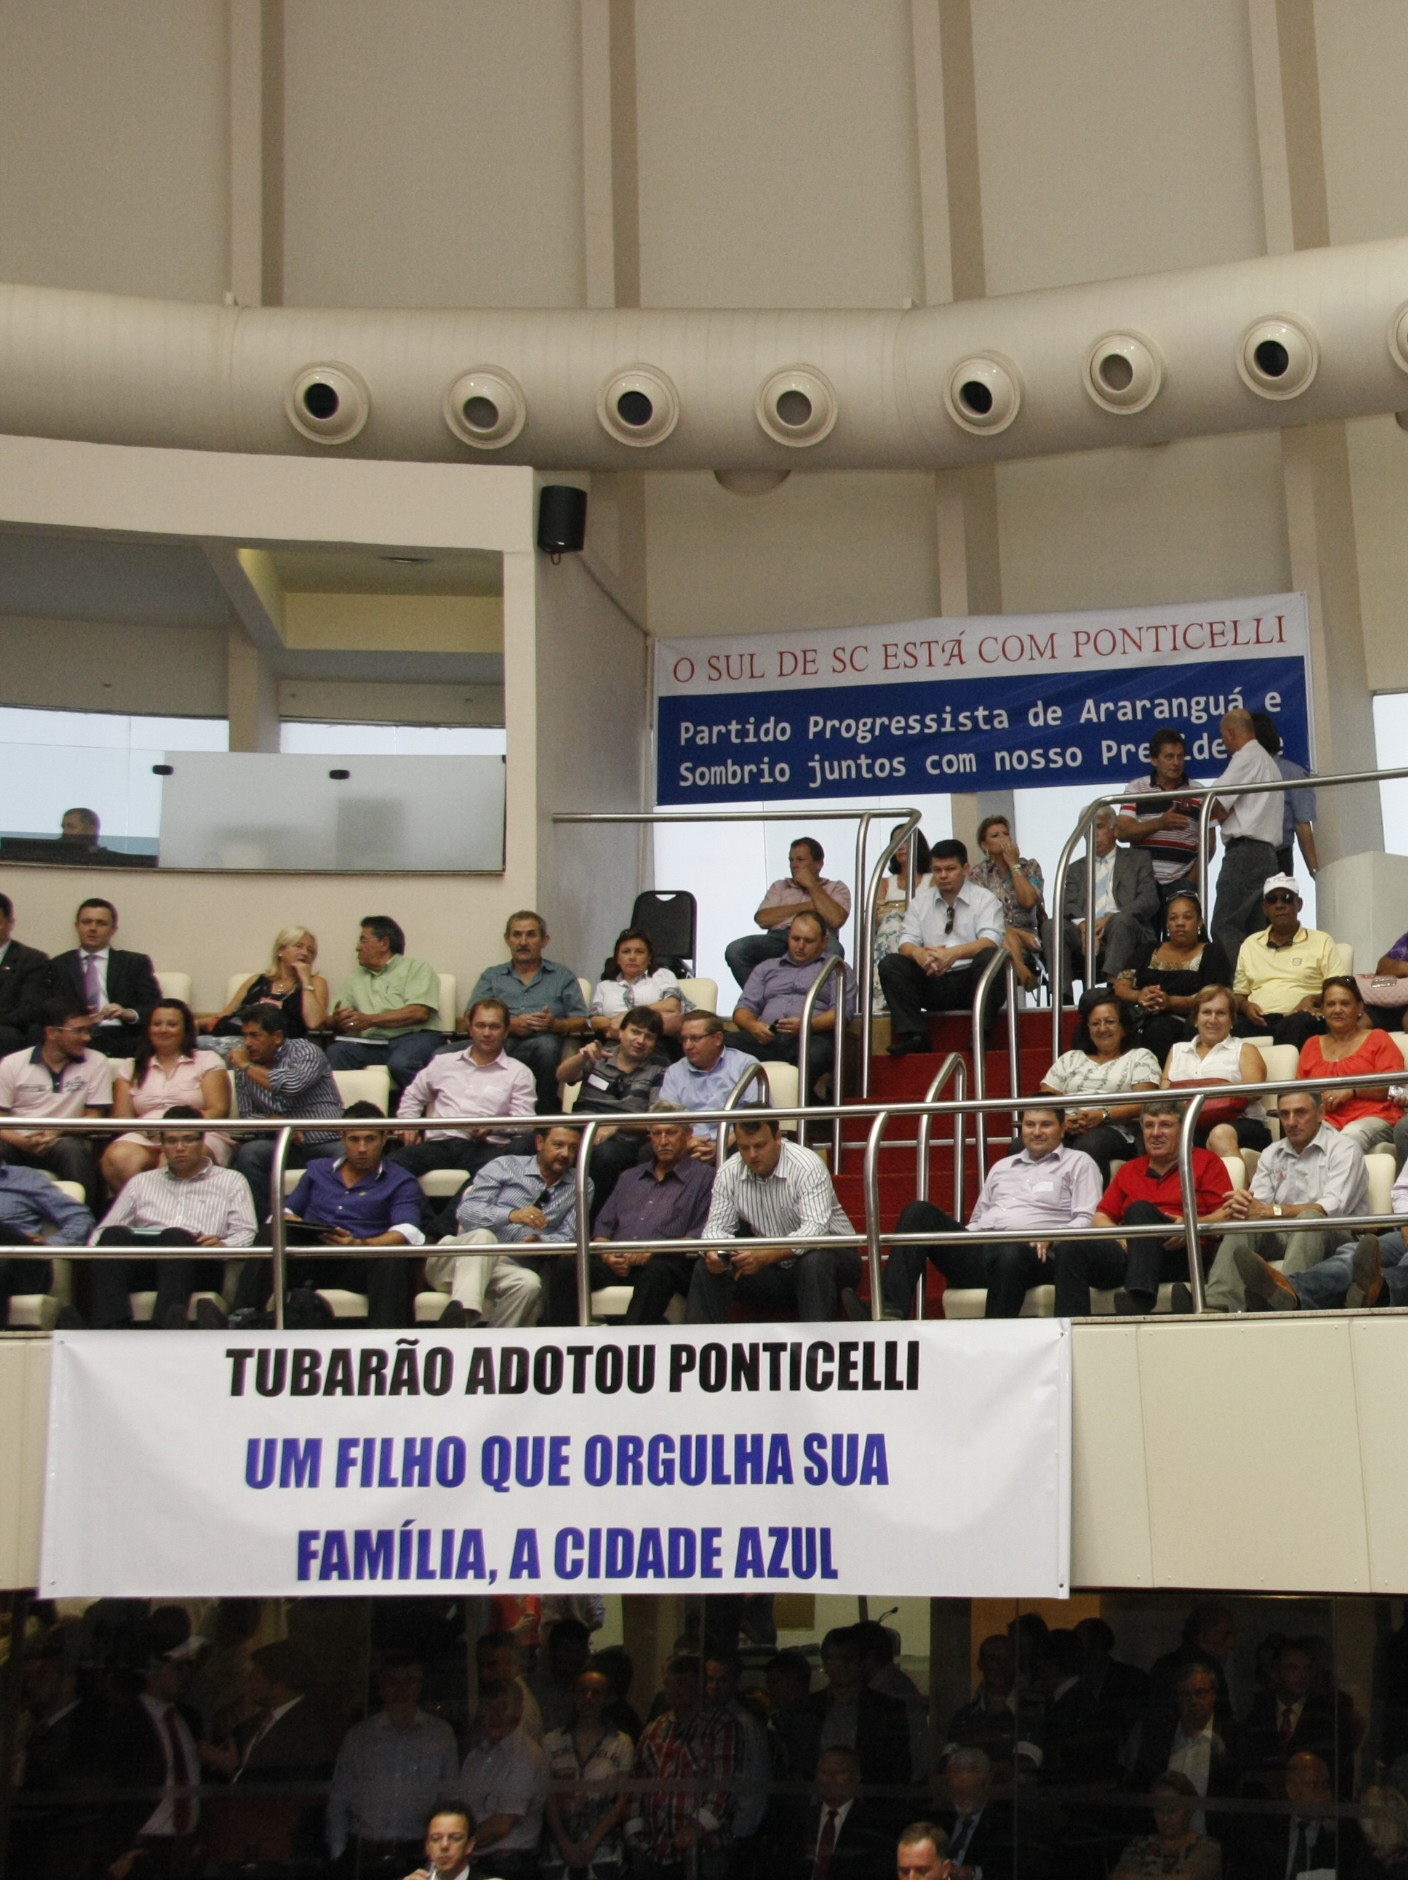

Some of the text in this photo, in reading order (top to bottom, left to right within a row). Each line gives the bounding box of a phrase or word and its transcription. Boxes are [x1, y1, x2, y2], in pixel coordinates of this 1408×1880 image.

[673, 616, 1287, 684] O SUL DE SC ESTÁ COM PONTICELLI
[681, 687, 1281, 744] Partido Progressista de Araranguá e
[681, 757, 789, 786] Sombrio
[809, 755, 905, 787] juntos
[926, 754, 976, 774] com
[995, 747, 1082, 770] nosso
[225, 1338, 919, 1397] TUBARÃO ADOTOU PONTICELLI
[245, 1433, 888, 1492] UM FILHO QUE ORGULHA SUA
[297, 1519, 838, 1585] FAMÍLIA, A CIDADE AZUL
